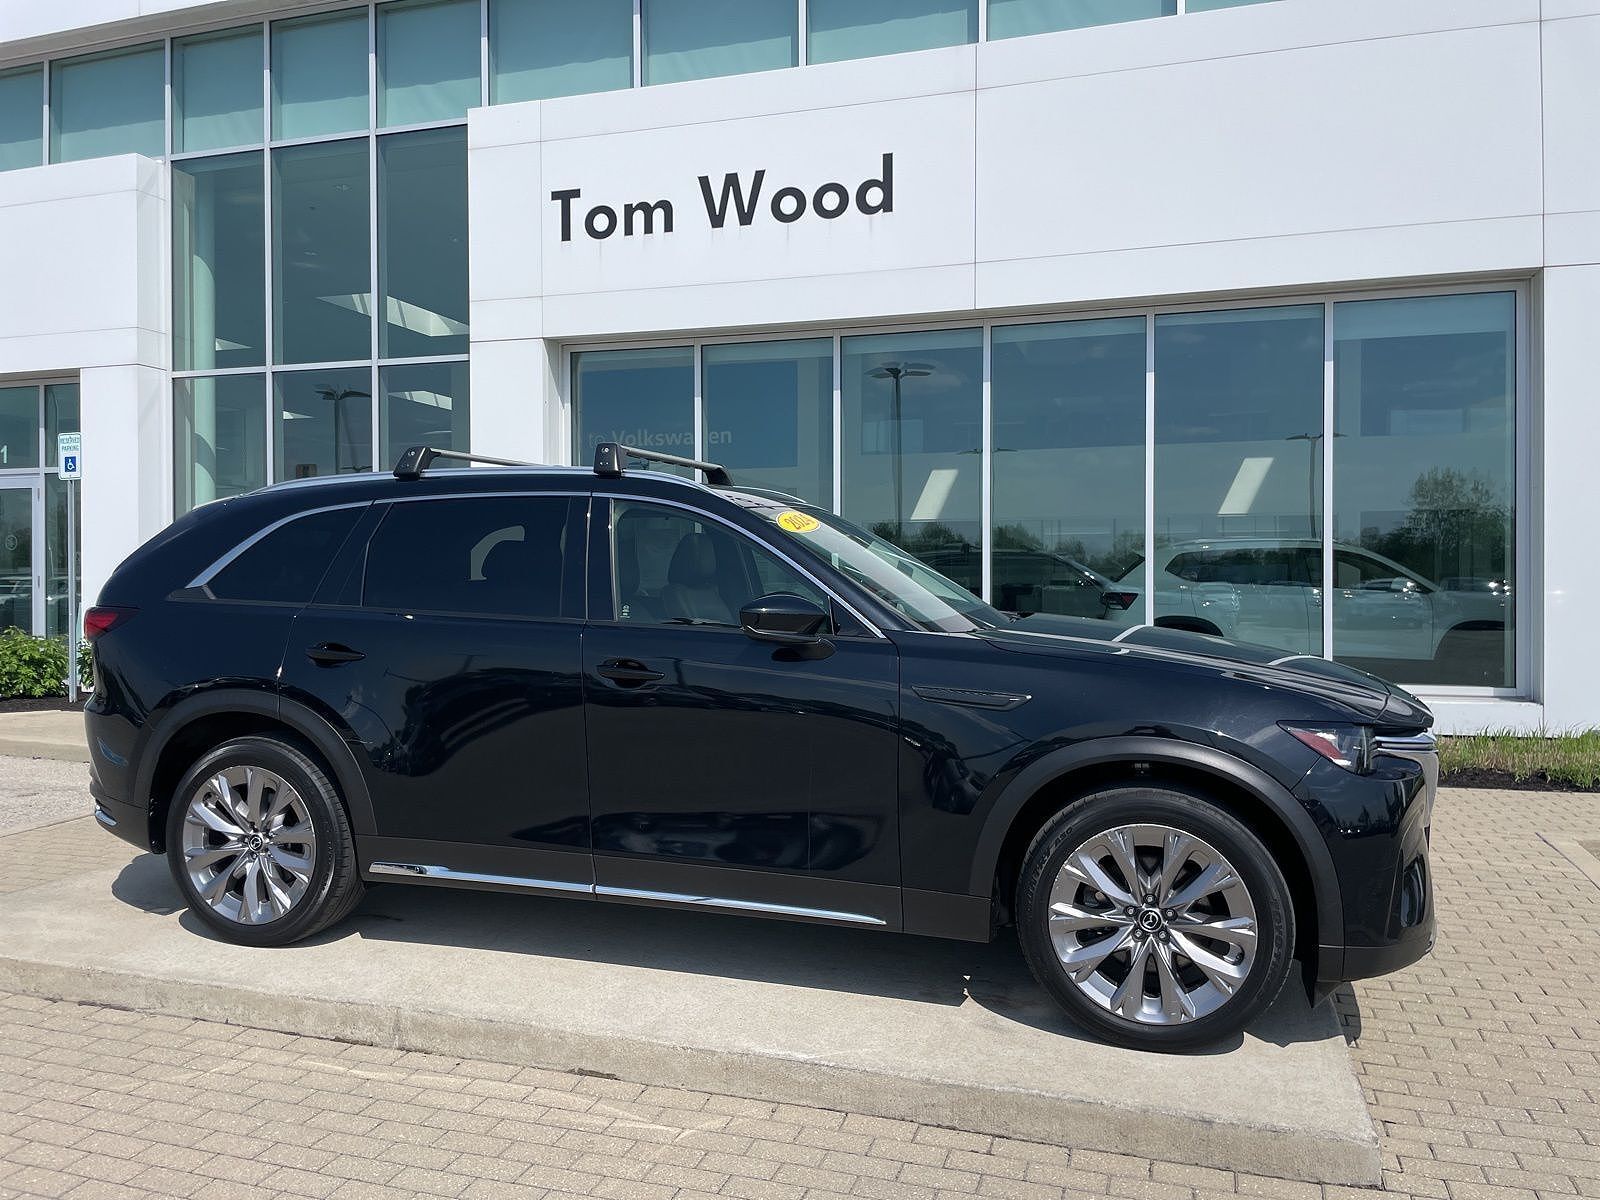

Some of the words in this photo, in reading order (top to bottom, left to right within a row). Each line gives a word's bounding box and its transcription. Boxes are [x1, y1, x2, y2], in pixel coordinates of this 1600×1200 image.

[551, 188, 674, 241] Tom
[697, 152, 894, 229] Wood
[611, 428, 732, 447] Volkswaen
